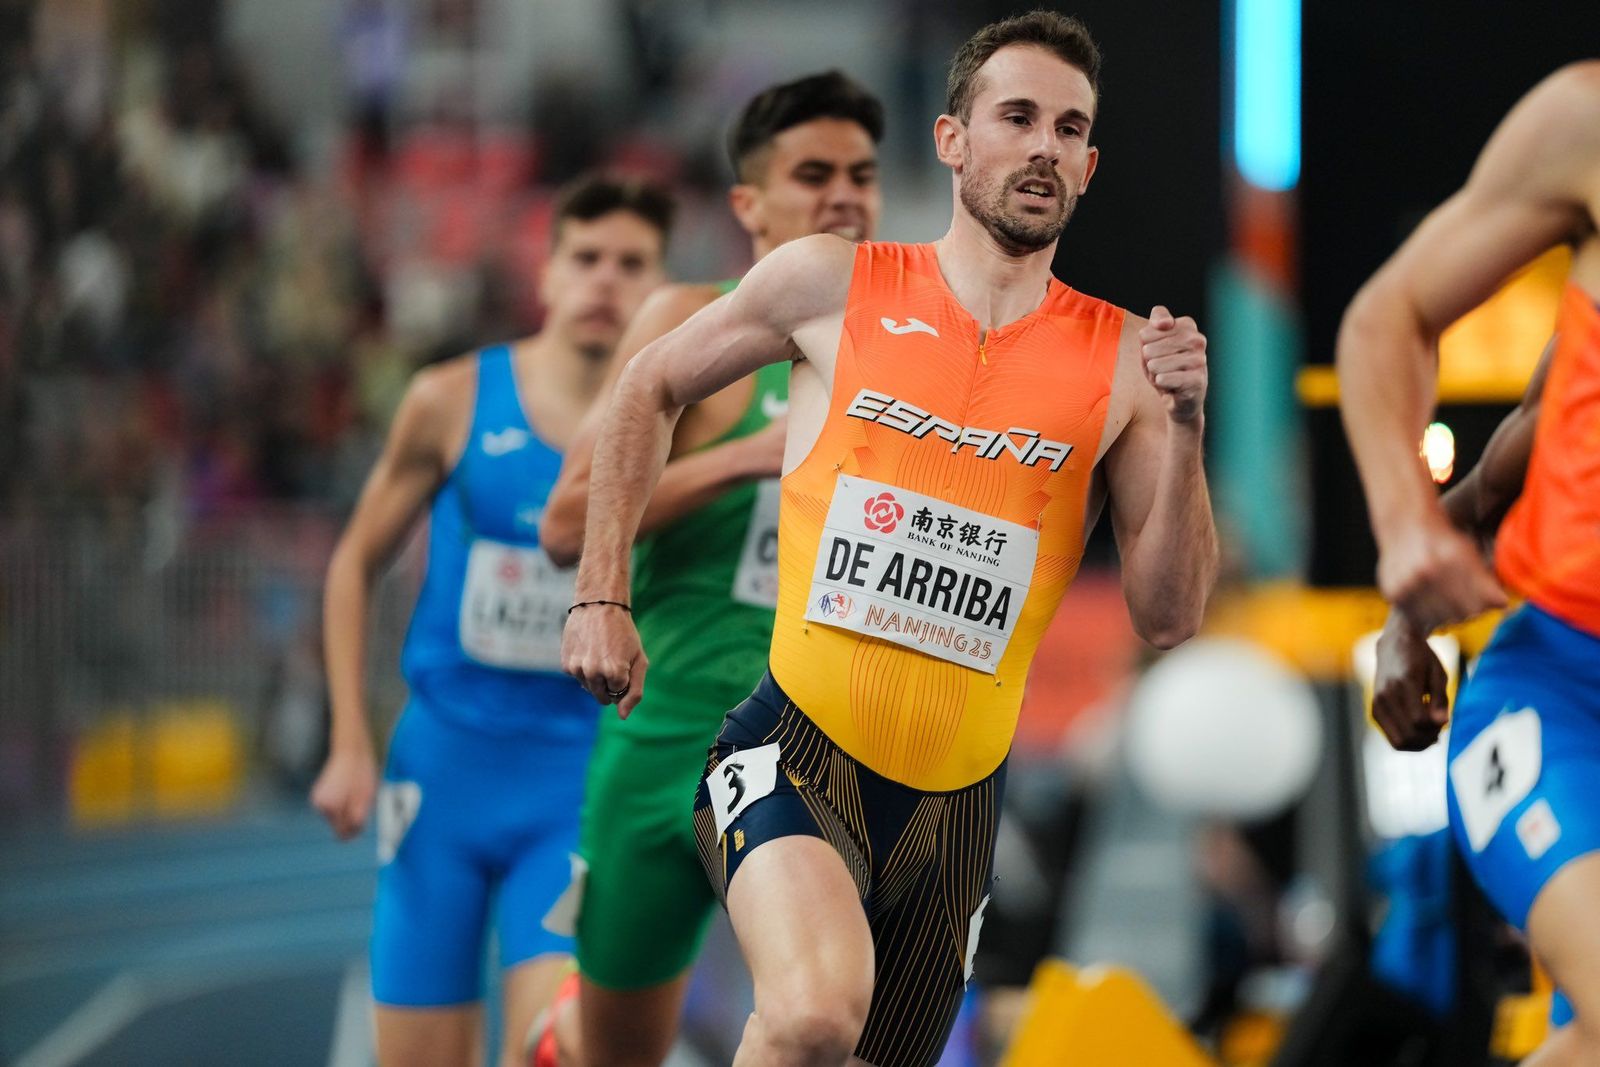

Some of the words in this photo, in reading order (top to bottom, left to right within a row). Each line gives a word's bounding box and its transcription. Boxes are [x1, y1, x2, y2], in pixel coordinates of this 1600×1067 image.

[846, 388, 1074, 472] ESPAÑA
[907, 532, 937, 547] BANK
[940, 542, 953, 552] OF
[956, 547, 1000, 567] NANJING
[910, 506, 1008, 556] 南京银行
[825, 537, 875, 587] DE
[876, 552, 1012, 630] ARRIBA
[723, 763, 746, 815] 3
